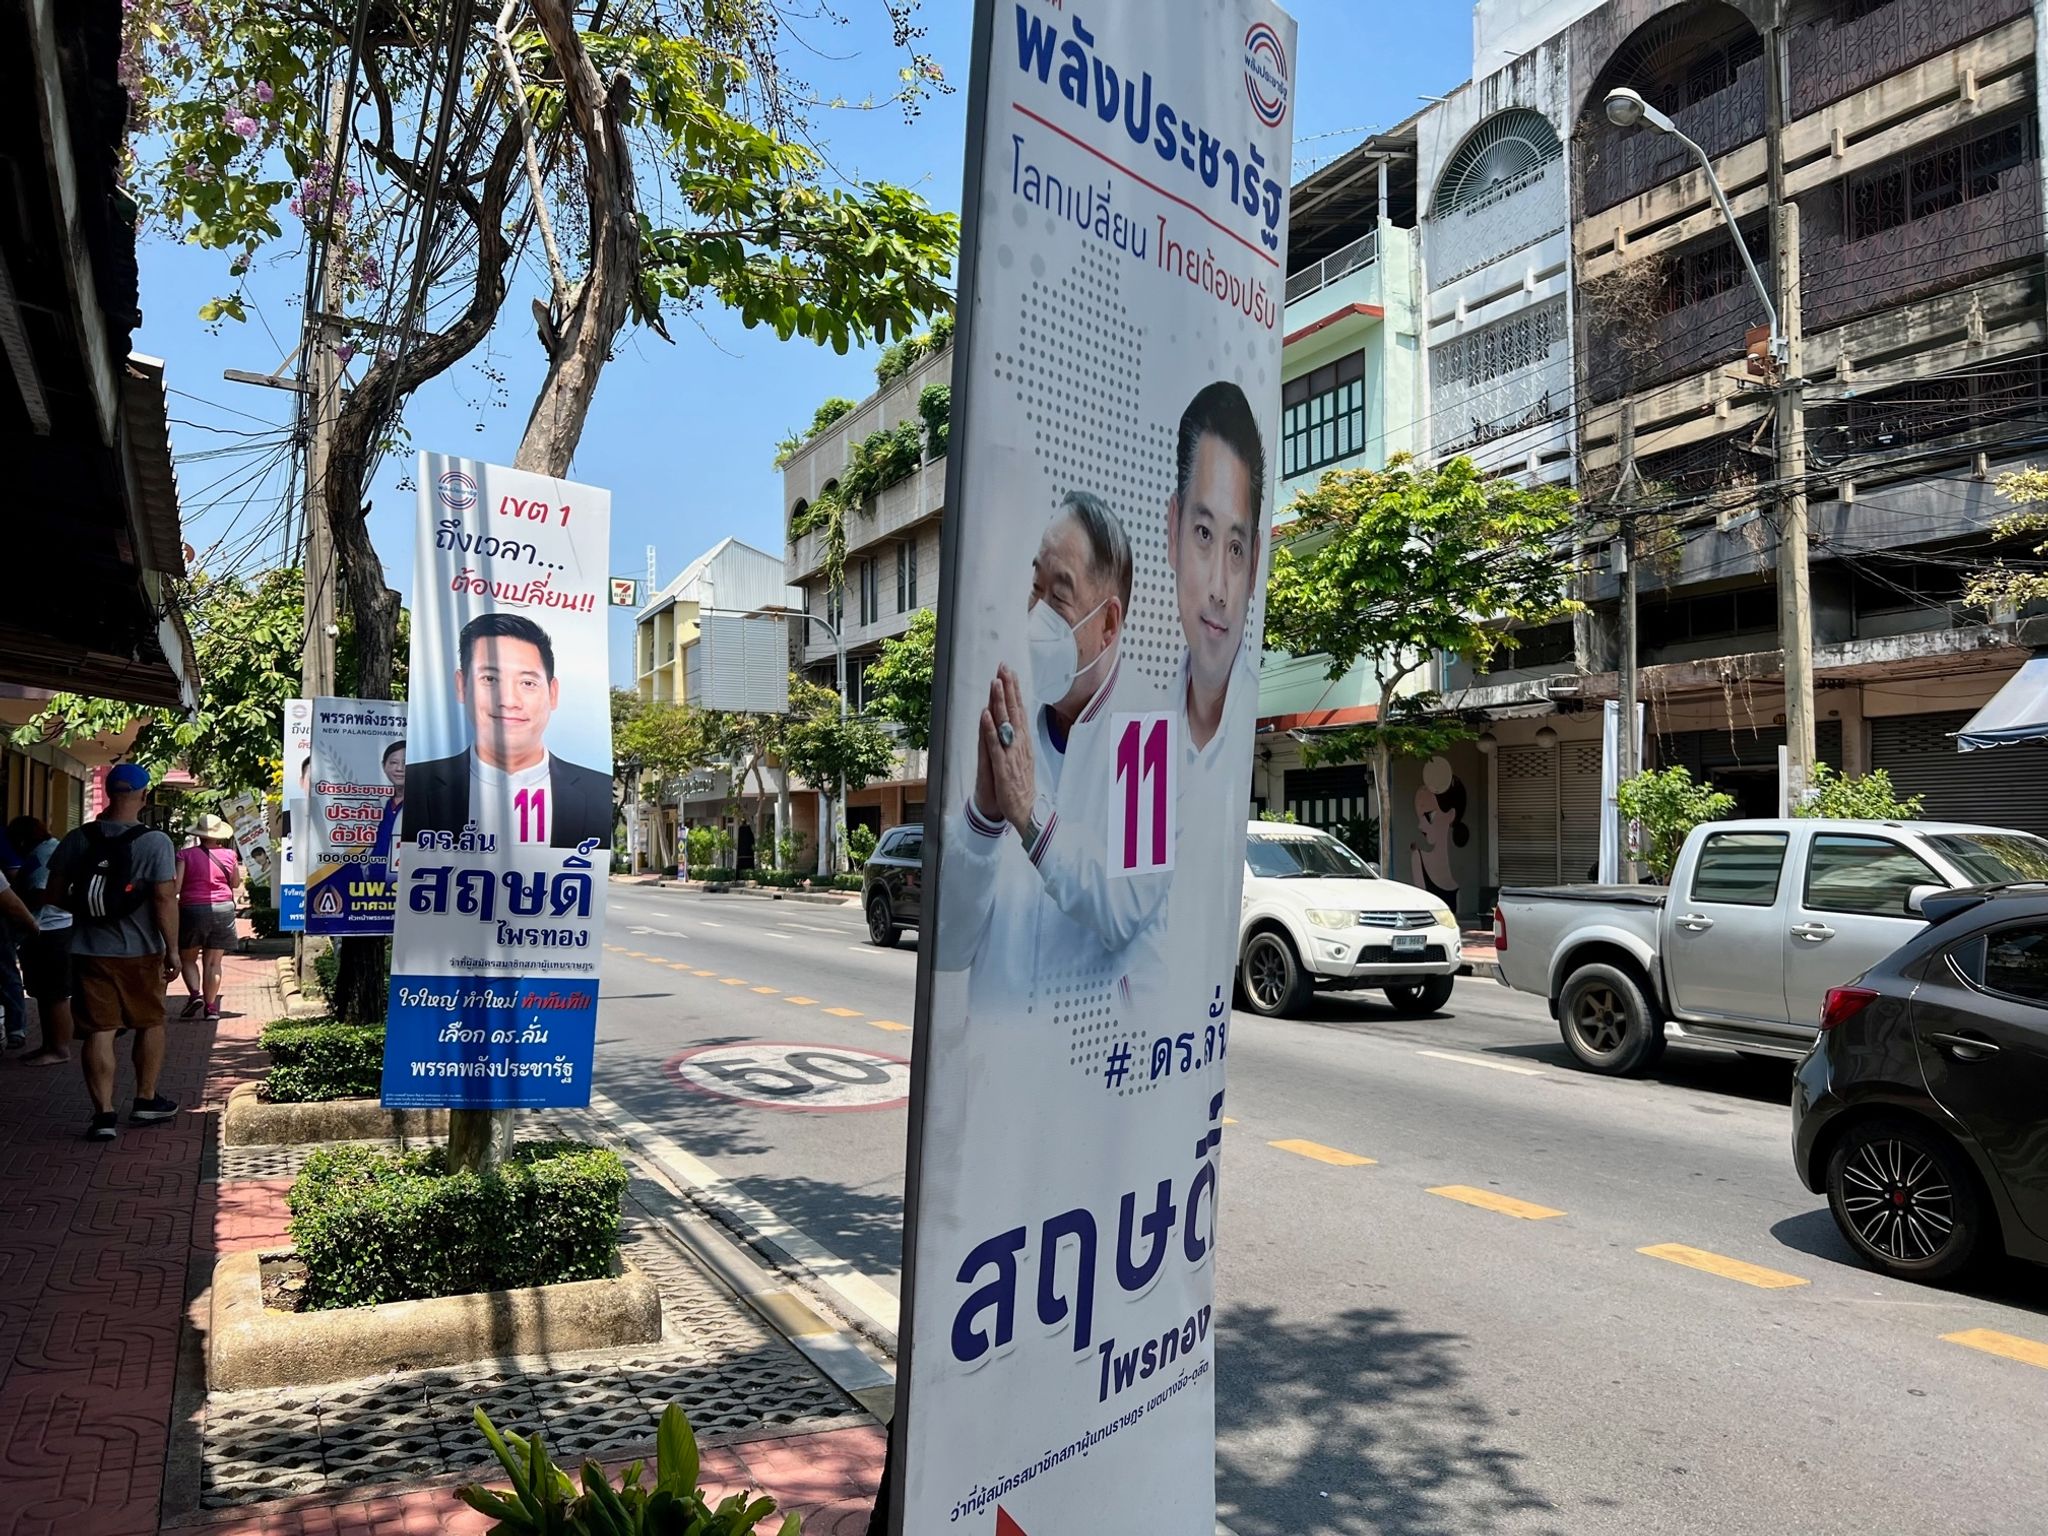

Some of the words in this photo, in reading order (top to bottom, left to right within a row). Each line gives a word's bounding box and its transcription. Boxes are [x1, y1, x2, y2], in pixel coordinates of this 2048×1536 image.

[1015, 3, 1282, 250] พลังประชารัฐ
[1012, 134, 1147, 260] โลกเปลี่ยน
[1157, 214, 1276, 330] ไทยต้องปรับ
[499, 495, 549, 524] เขต
[559, 505, 572, 527] 1
[436, 518, 565, 570] ถึงเวลา...
[451, 567, 596, 613] ต้องเปลี่ยน!!
[327, 804, 382, 820] ประกัน
[513, 788, 546, 843] 11
[1117, 719, 1168, 869] 11
[331, 825, 377, 842] ตัวได้
[417, 819, 497, 852] ดร.ลั่น
[318, 854, 368, 864] 100,000
[408, 838, 600, 922] สฤษดิ์
[496, 920, 589, 948] ไพรทอง
[399, 987, 460, 1011] ใจใหญ่
[462, 989, 519, 1009] ทำใหม่
[437, 1020, 486, 1044] เลือก
[490, 1015, 549, 1044] ดร.ลั่น
[410, 1055, 574, 1083] พรรคพลังประชารัฐ
[692, 1051, 892, 1096] 50
[1098, 1304, 1212, 1404] ไพรทอง
[950, 1406, 1144, 1522] ว่าที่ผู้สมัครสมาชิกสภาผู้แทนราษฎร
